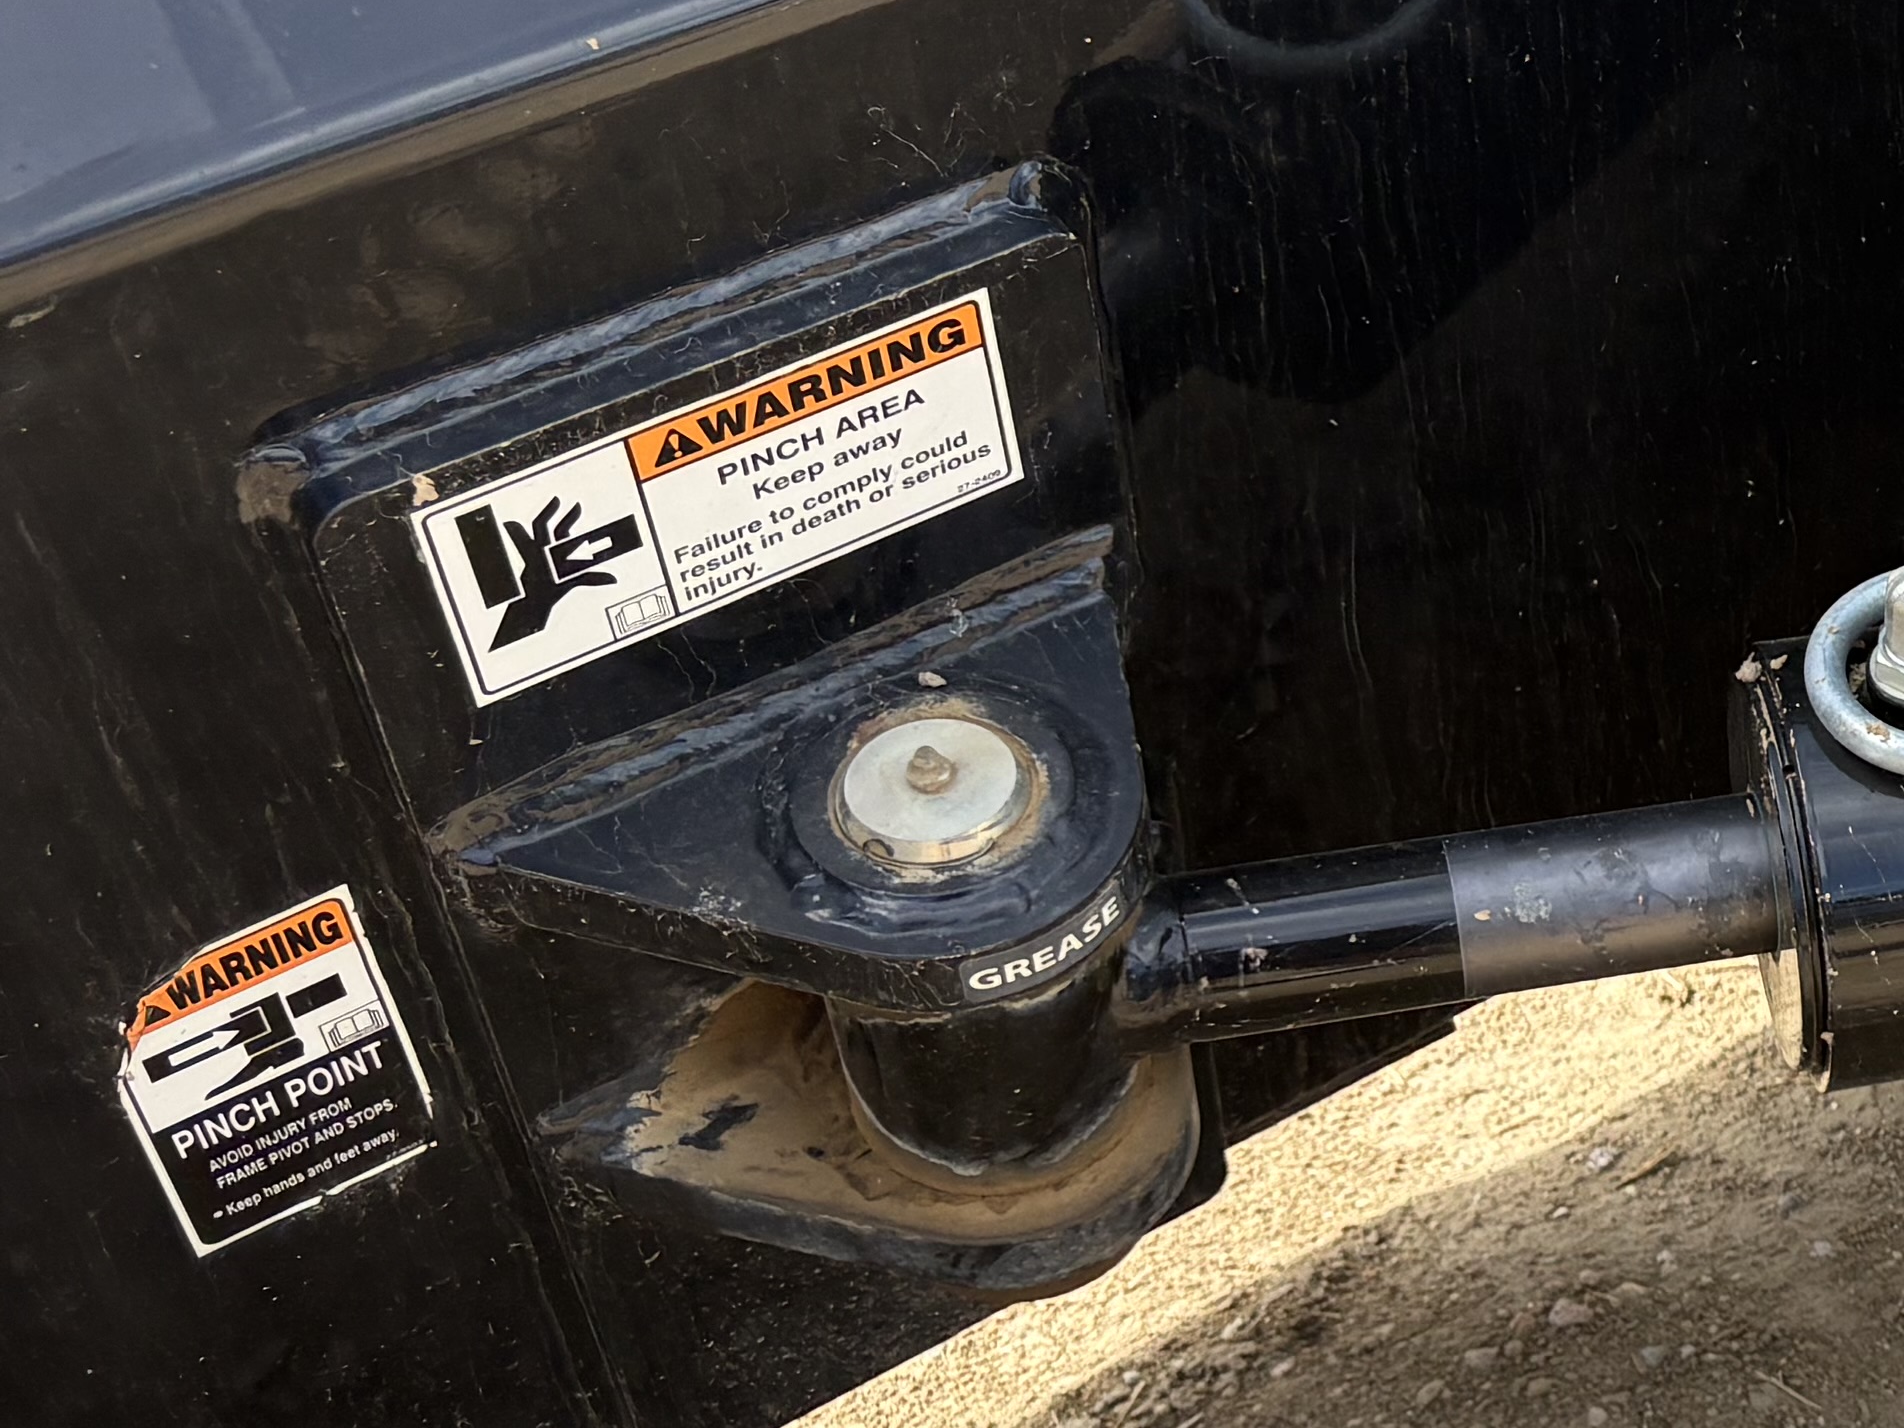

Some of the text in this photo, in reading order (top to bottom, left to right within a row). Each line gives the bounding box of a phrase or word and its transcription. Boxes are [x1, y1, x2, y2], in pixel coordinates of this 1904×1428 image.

[696, 318, 966, 445] WARNING
[717, 388, 925, 486] PINCH AREA
[752, 427, 902, 500] Keep away
[673, 430, 968, 565] Failure to comply could
[679, 444, 992, 583] result in death or serious
[684, 562, 763, 601] injury.
[165, 911, 344, 1010] WARNING
[969, 896, 1120, 990] GREASE
[171, 1040, 383, 1159] PINCH POINT
[209, 1097, 352, 1173] AVOID INJURY FROM
[216, 1098, 398, 1189] FRAME PIVOT AND STOPS.
[225, 1193, 262, 1216] Keep
[262, 1172, 306, 1198] hands
[307, 1157, 333, 1178] and
[333, 1145, 361, 1165] feet
[362, 1128, 400, 1152] away.
